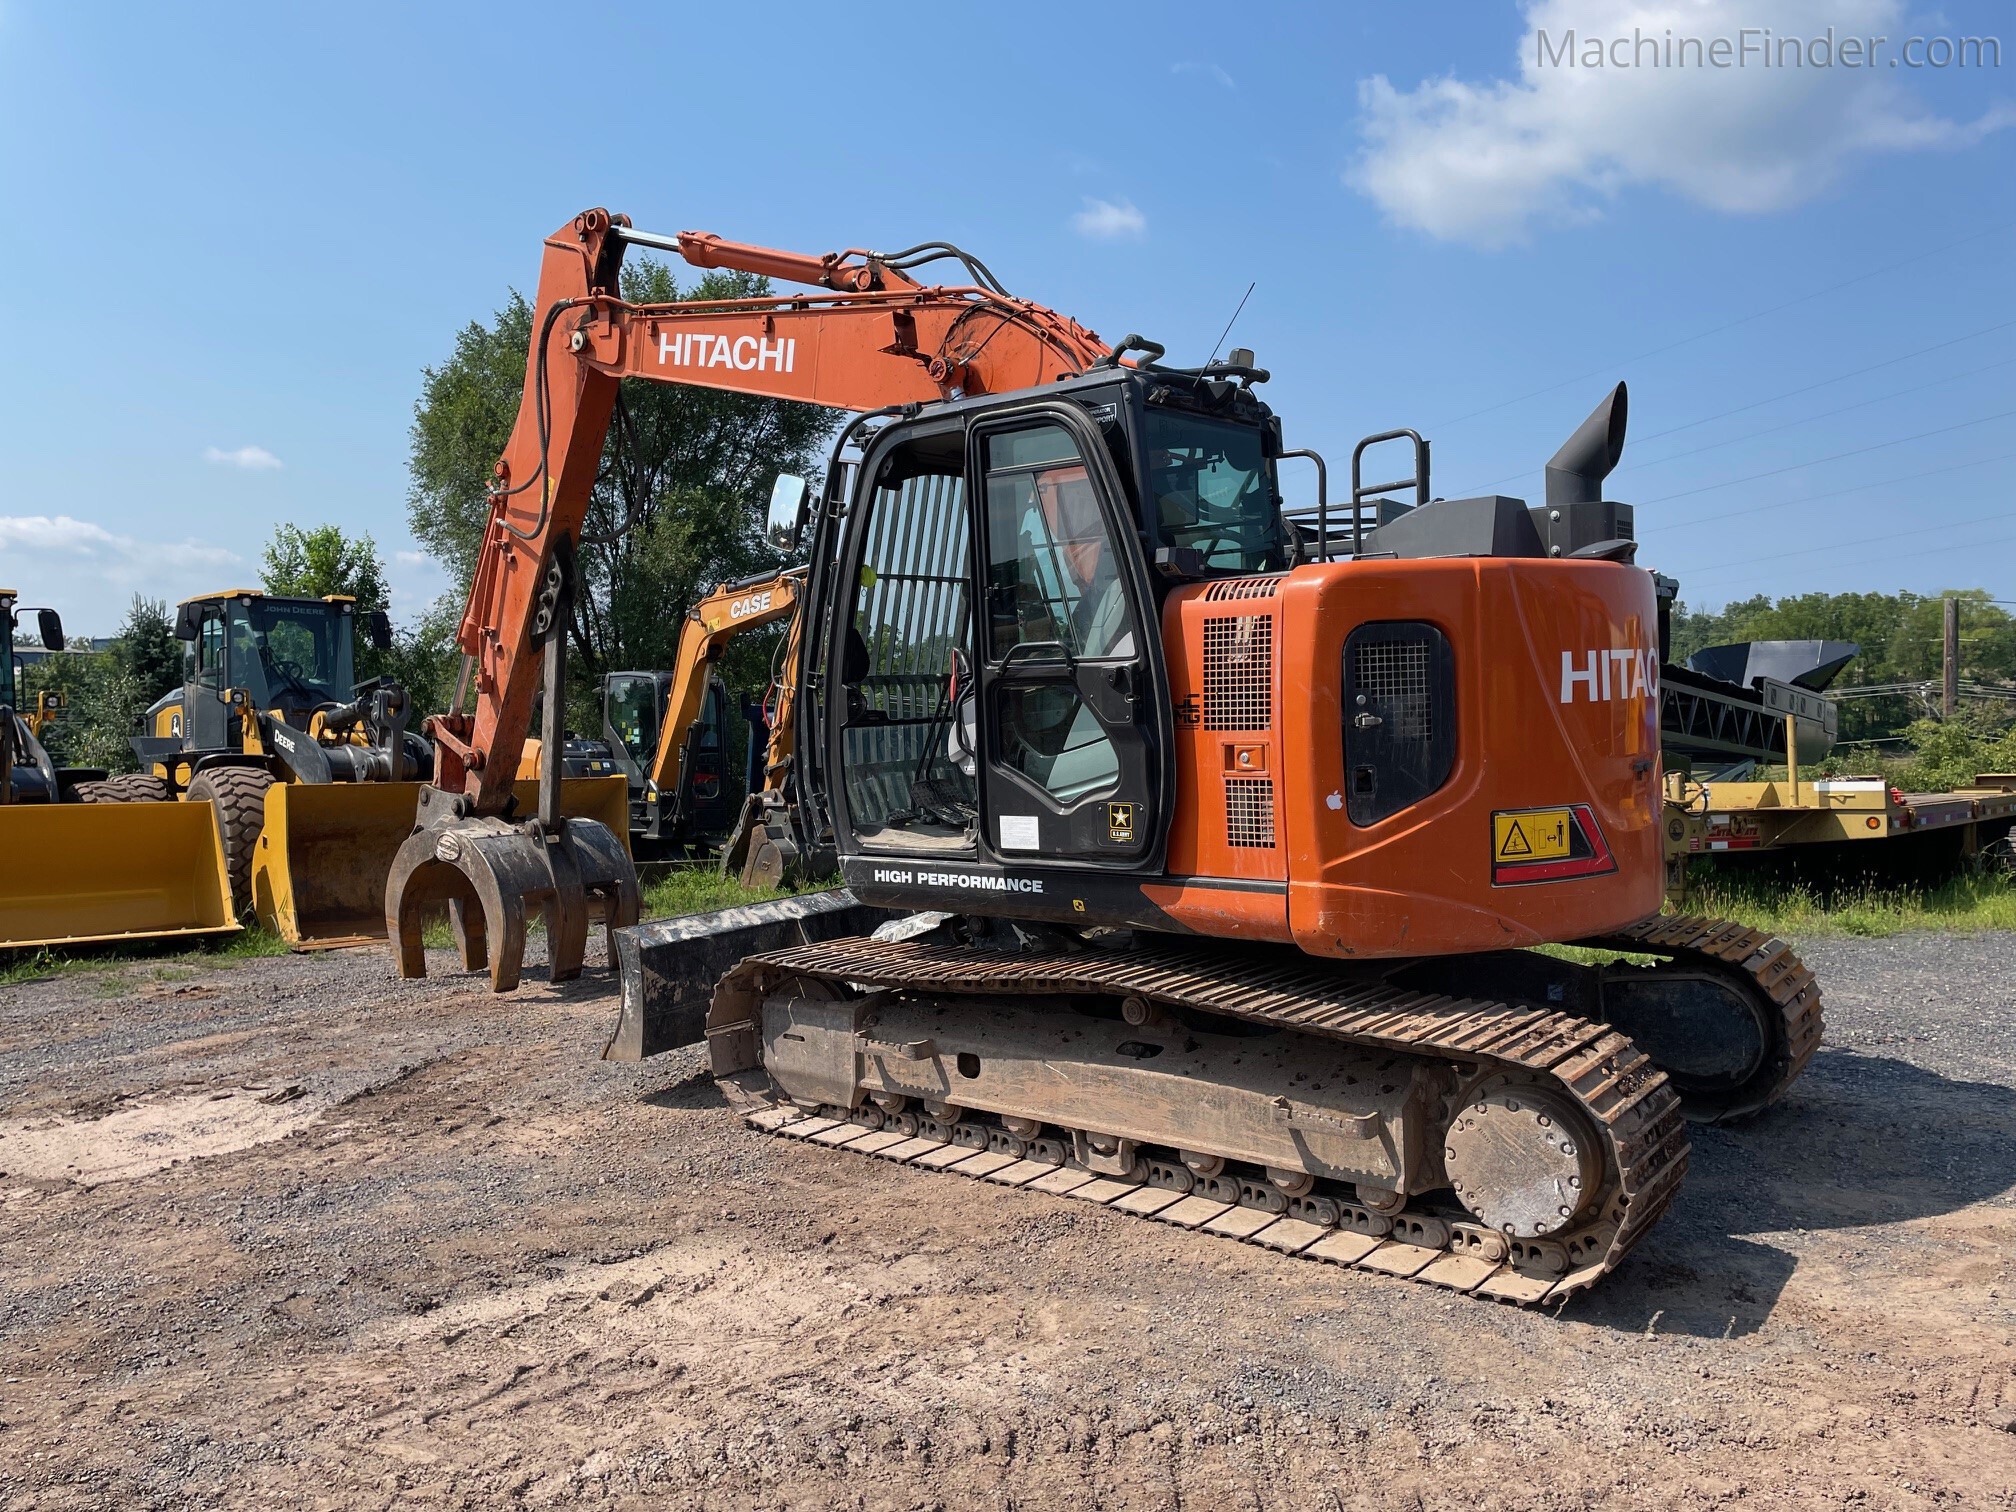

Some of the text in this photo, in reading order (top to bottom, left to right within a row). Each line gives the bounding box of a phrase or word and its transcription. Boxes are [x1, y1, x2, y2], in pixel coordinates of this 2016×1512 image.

[658, 332, 796, 373] HITACHI
[264, 605, 325, 615] JOHN DEERE
[730, 591, 771, 619] CASE
[1560, 647, 1660, 703] HITAC
[274, 729, 295, 754] DEERE
[874, 869, 1043, 893] HIGH PERFORMANCE
